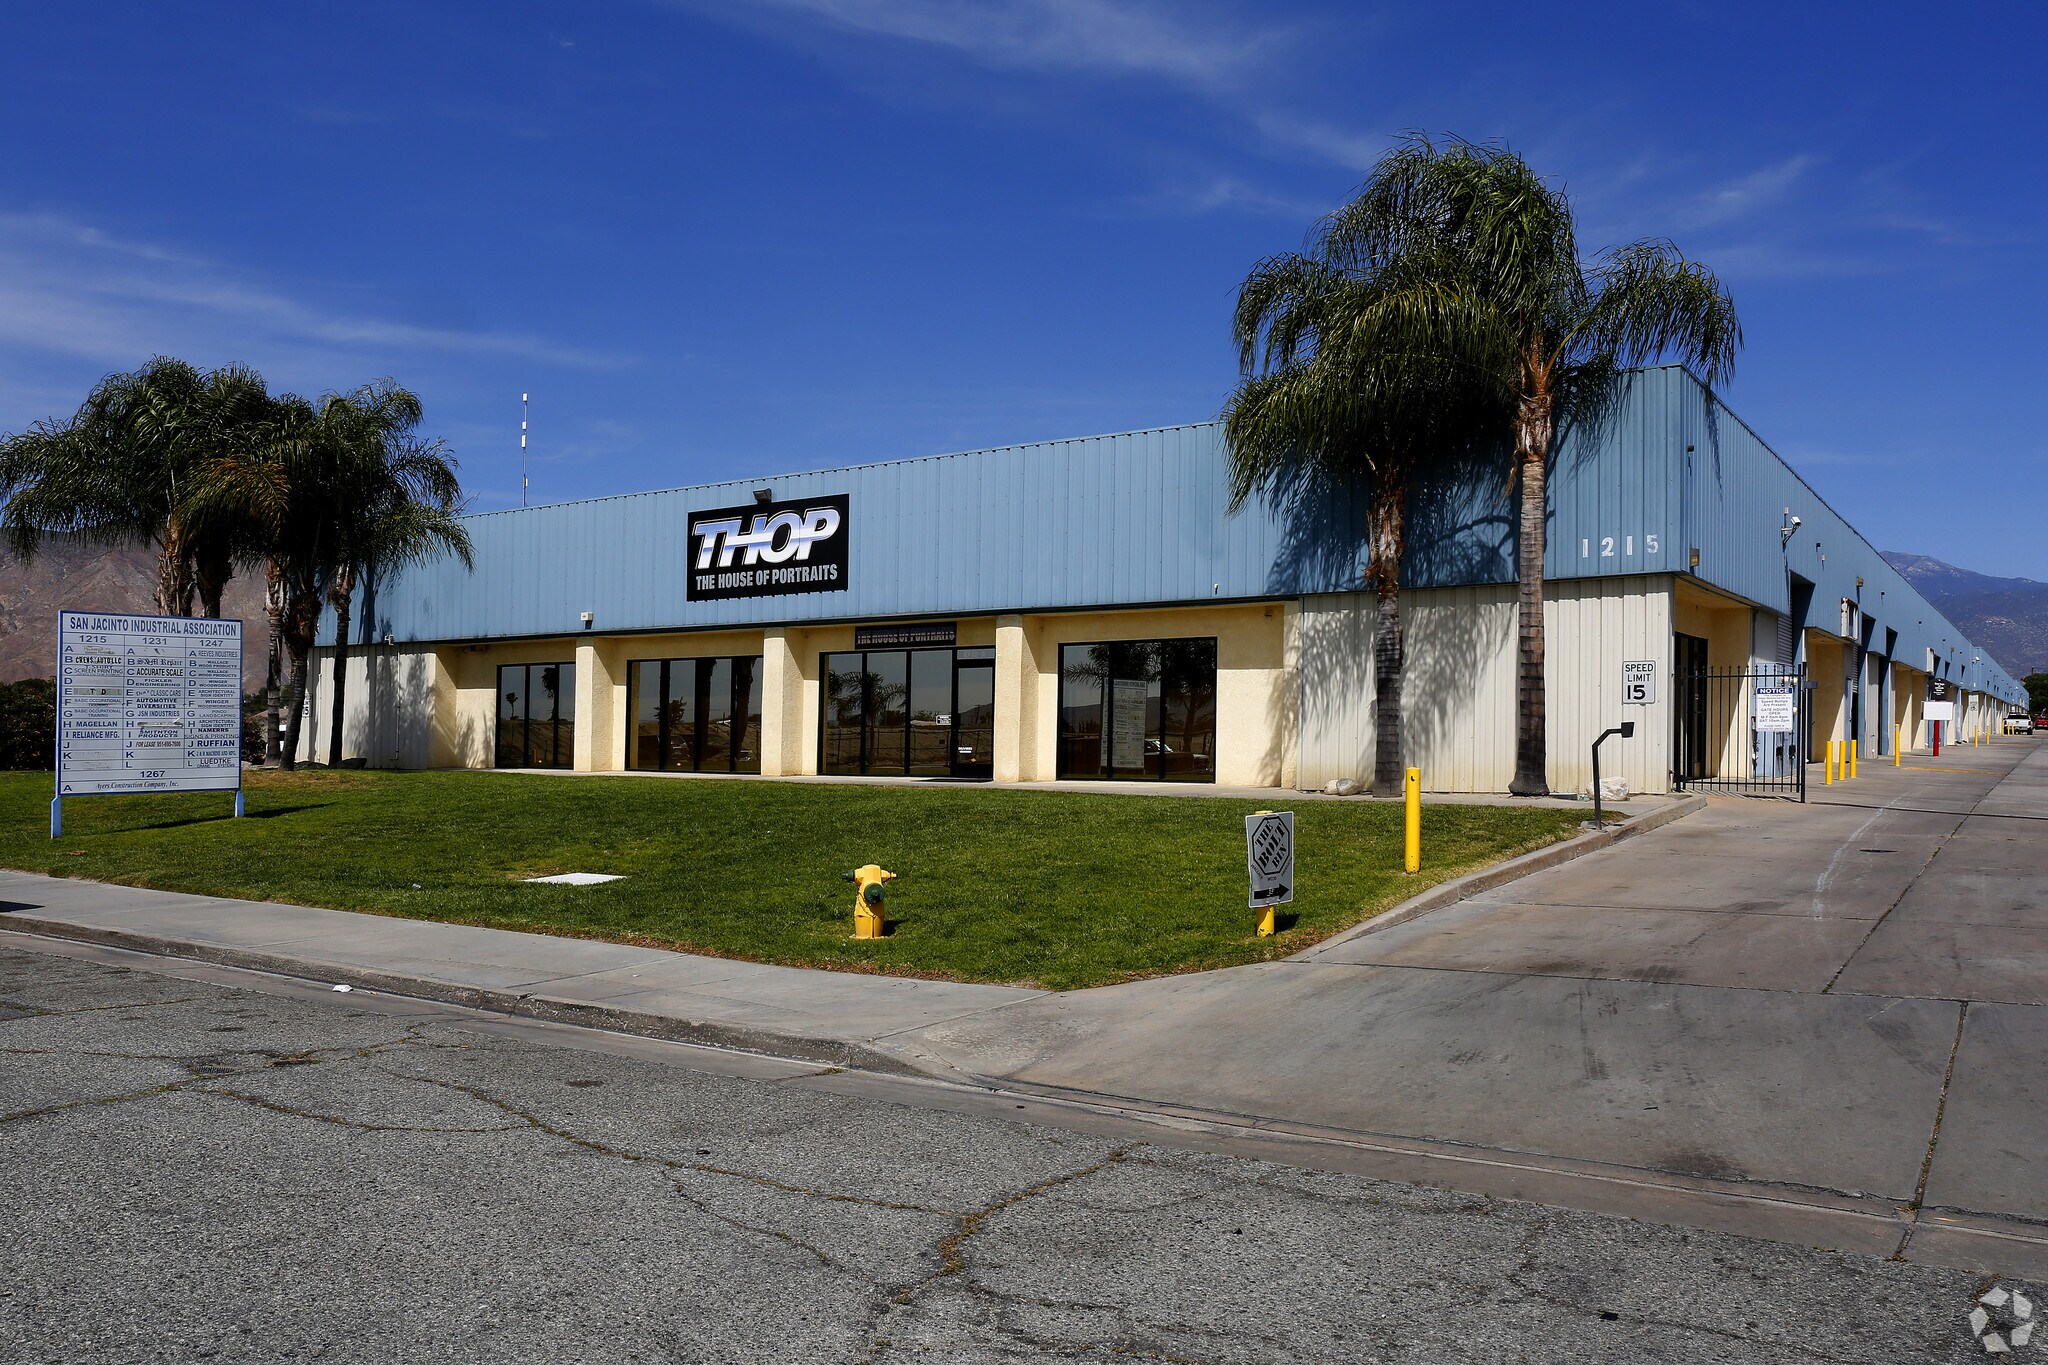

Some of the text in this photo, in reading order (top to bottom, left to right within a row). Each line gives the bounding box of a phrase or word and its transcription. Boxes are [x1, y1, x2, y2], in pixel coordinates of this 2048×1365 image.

[692, 506, 840, 570] THOP
[1582, 534, 1659, 558] 1215
[695, 564, 838, 590] THE HOUSE OF PORTRAITS
[70, 616, 236, 636] SAN JACINTO INDUSTRIAL ASSOCIATION
[79, 635, 107, 643] 1215
[857, 630, 871, 644] THE
[872, 629, 898, 644] HOUSE
[910, 626, 955, 642] PORTRAITS
[142, 637, 167, 645] 1231
[199, 639, 224, 647] 1247
[215, 650, 238, 658] INDUSTRIES
[1625, 663, 1654, 672] SPEED
[126, 668, 183, 677] C ACCURATE SCALE
[126, 678, 135, 686] D
[1627, 673, 1651, 682] LIMIT
[1627, 684, 1646, 700] 15
[188, 720, 196, 728] H
[72, 731, 103, 739] RELIANCE
[104, 731, 120, 739] MFG.
[110, 781, 143, 789] Construction
[144, 780, 168, 789] Company,
[1255, 821, 1274, 848] THE
[1258, 822, 1286, 869] BOLT
[1271, 844, 1287, 869] BIN
